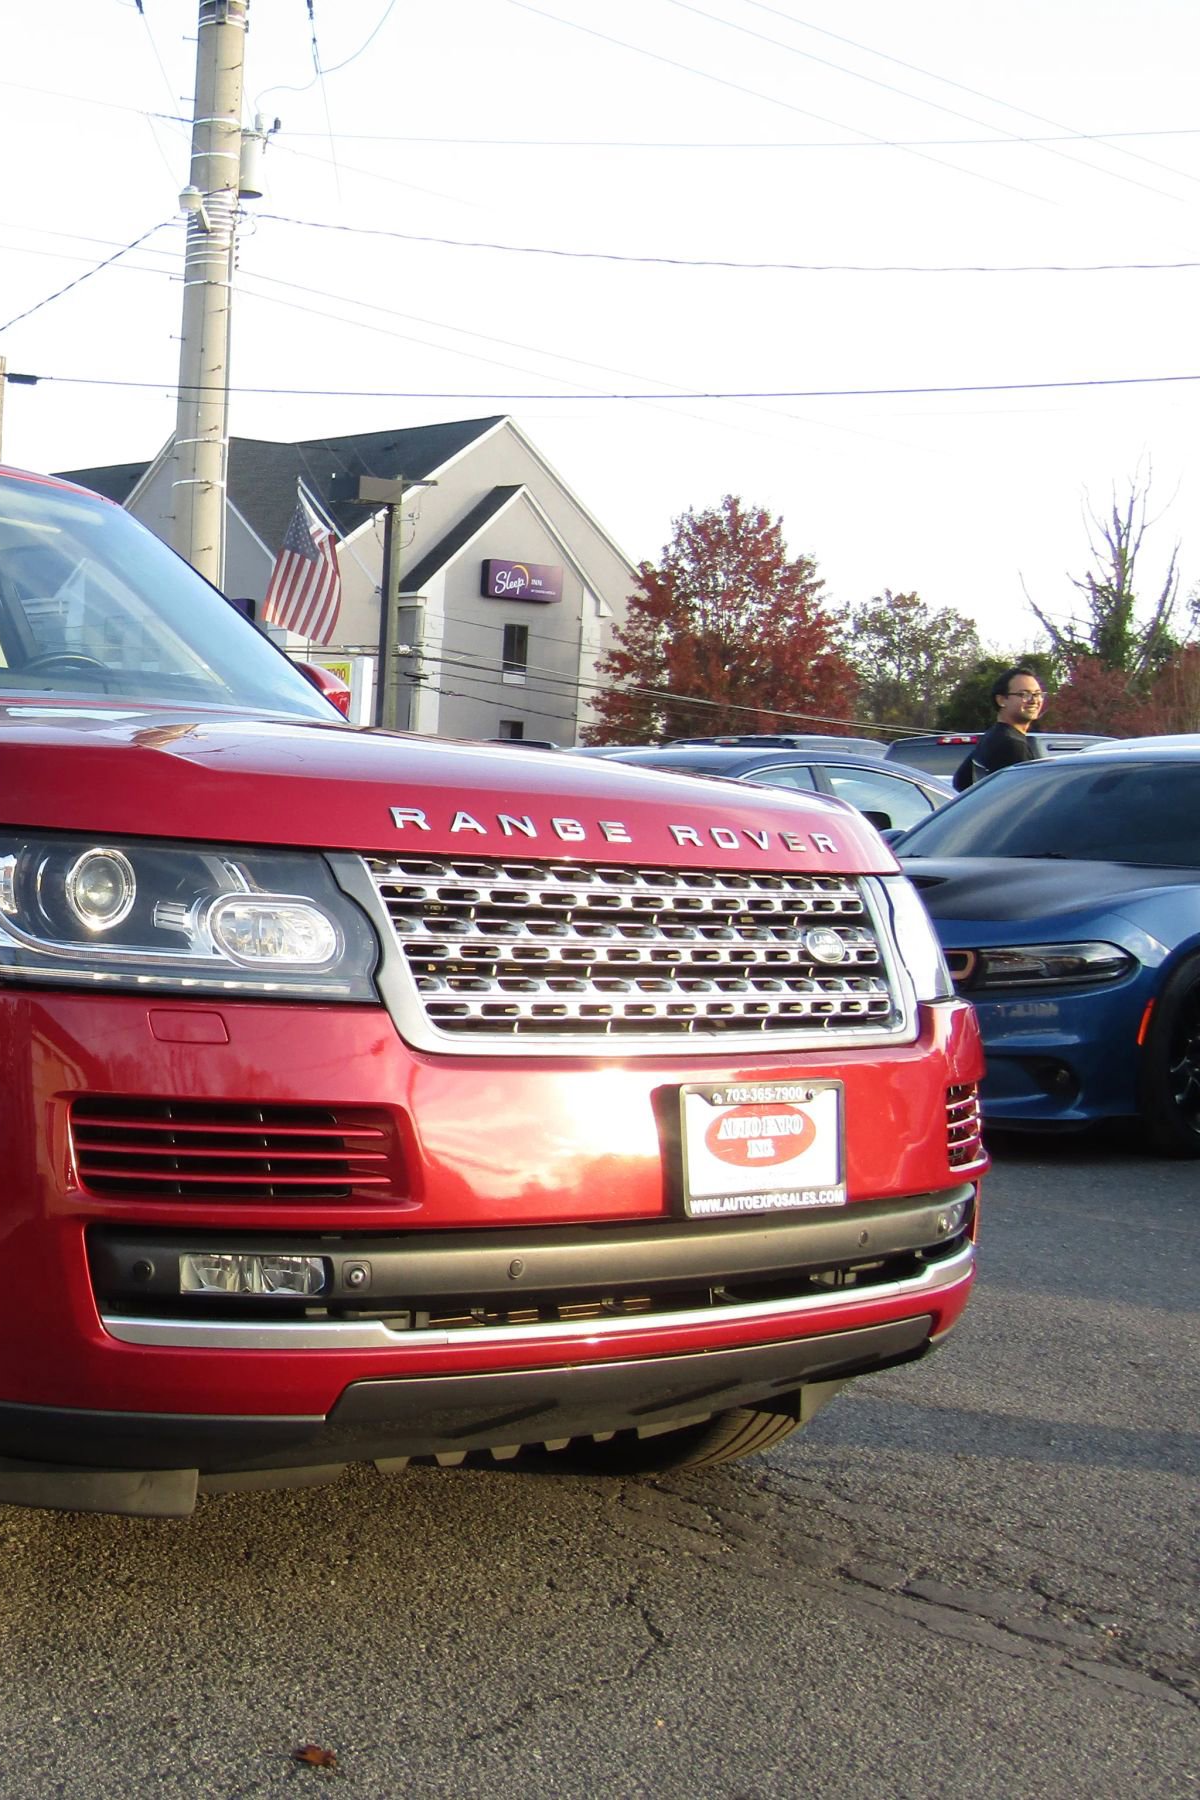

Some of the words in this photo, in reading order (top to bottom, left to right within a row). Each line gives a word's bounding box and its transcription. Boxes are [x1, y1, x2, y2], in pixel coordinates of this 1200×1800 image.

[494, 571, 526, 595] Sleep
[389, 806, 633, 843] RANGE
[668, 824, 839, 854] ROVER
[725, 1086, 802, 1102] 703-365-7900
[717, 1117, 762, 1140] AUTO
[762, 1114, 804, 1137] EXPO
[689, 1189, 845, 1215] WWW.AUTOEXPOSALES.COM
